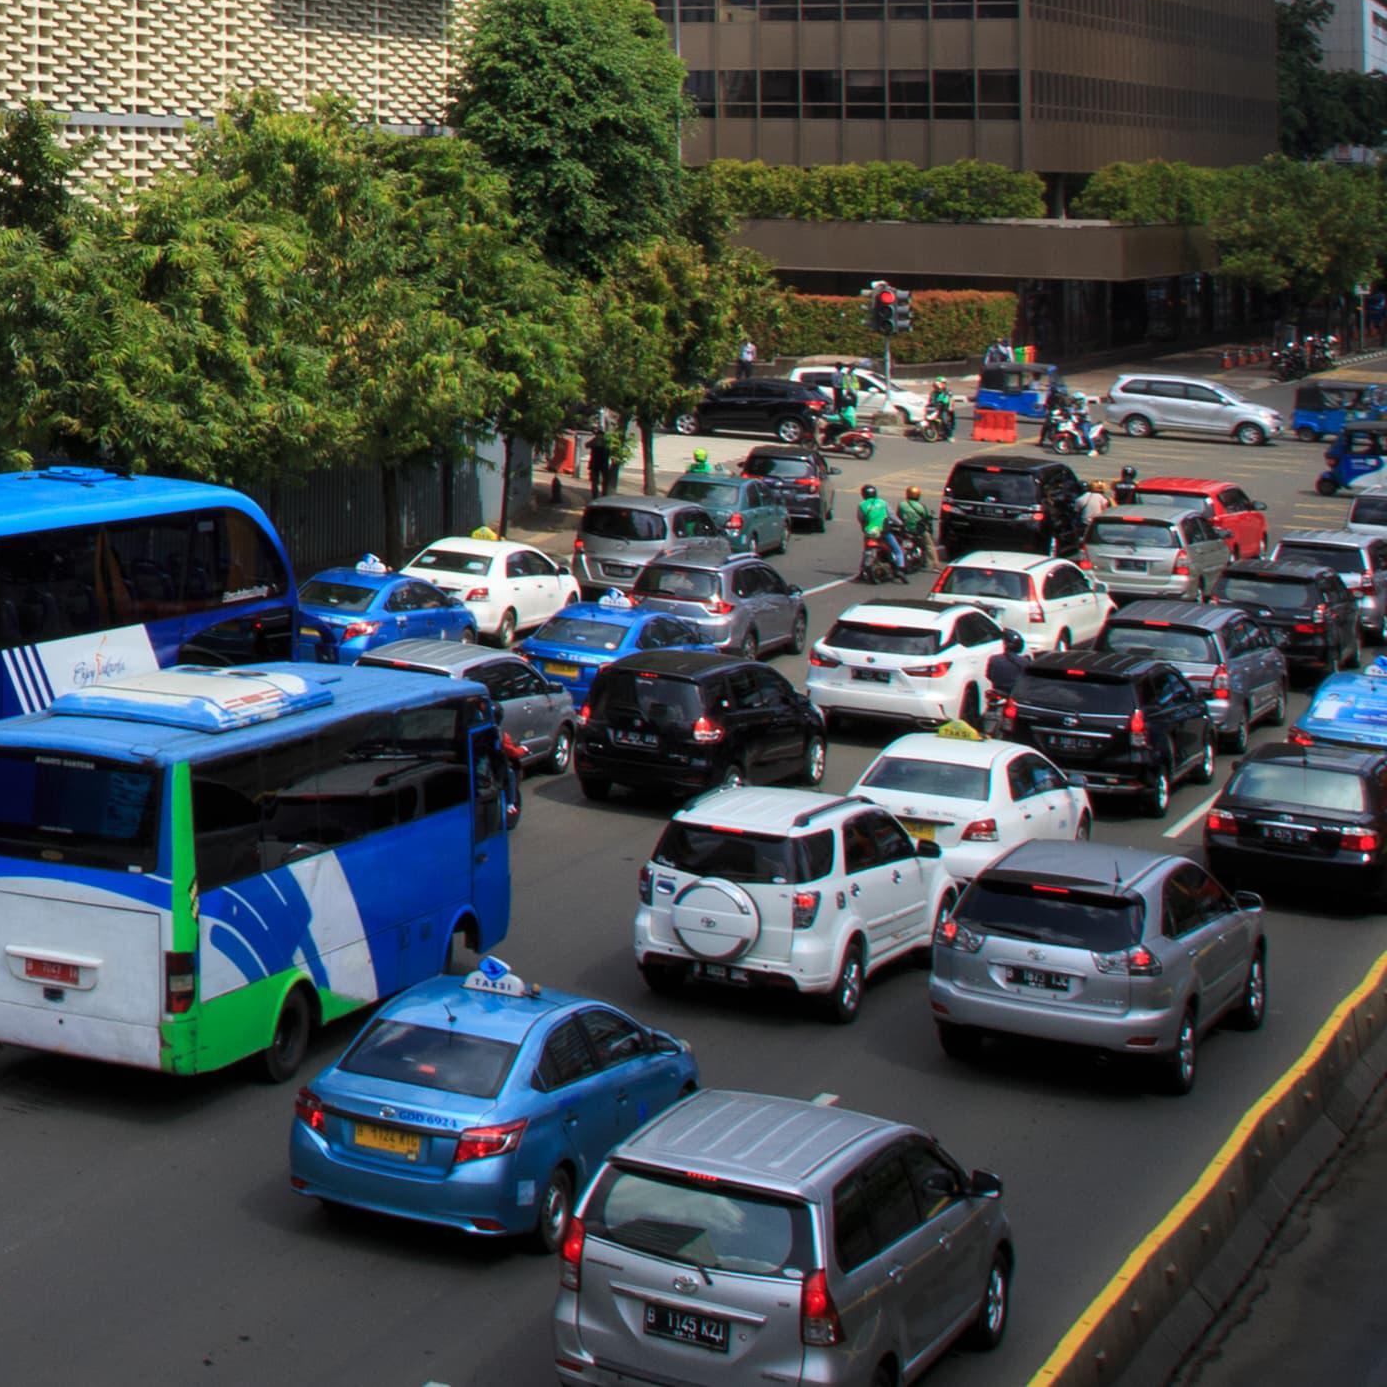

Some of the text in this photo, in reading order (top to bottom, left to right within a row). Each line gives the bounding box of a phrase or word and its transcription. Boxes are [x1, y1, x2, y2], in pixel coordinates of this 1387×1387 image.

[474, 977, 512, 991] TAKSI
[398, 1111, 425, 1123] GDD
[646, 1307, 656, 1323] B
[668, 1311, 697, 1333] 1145
